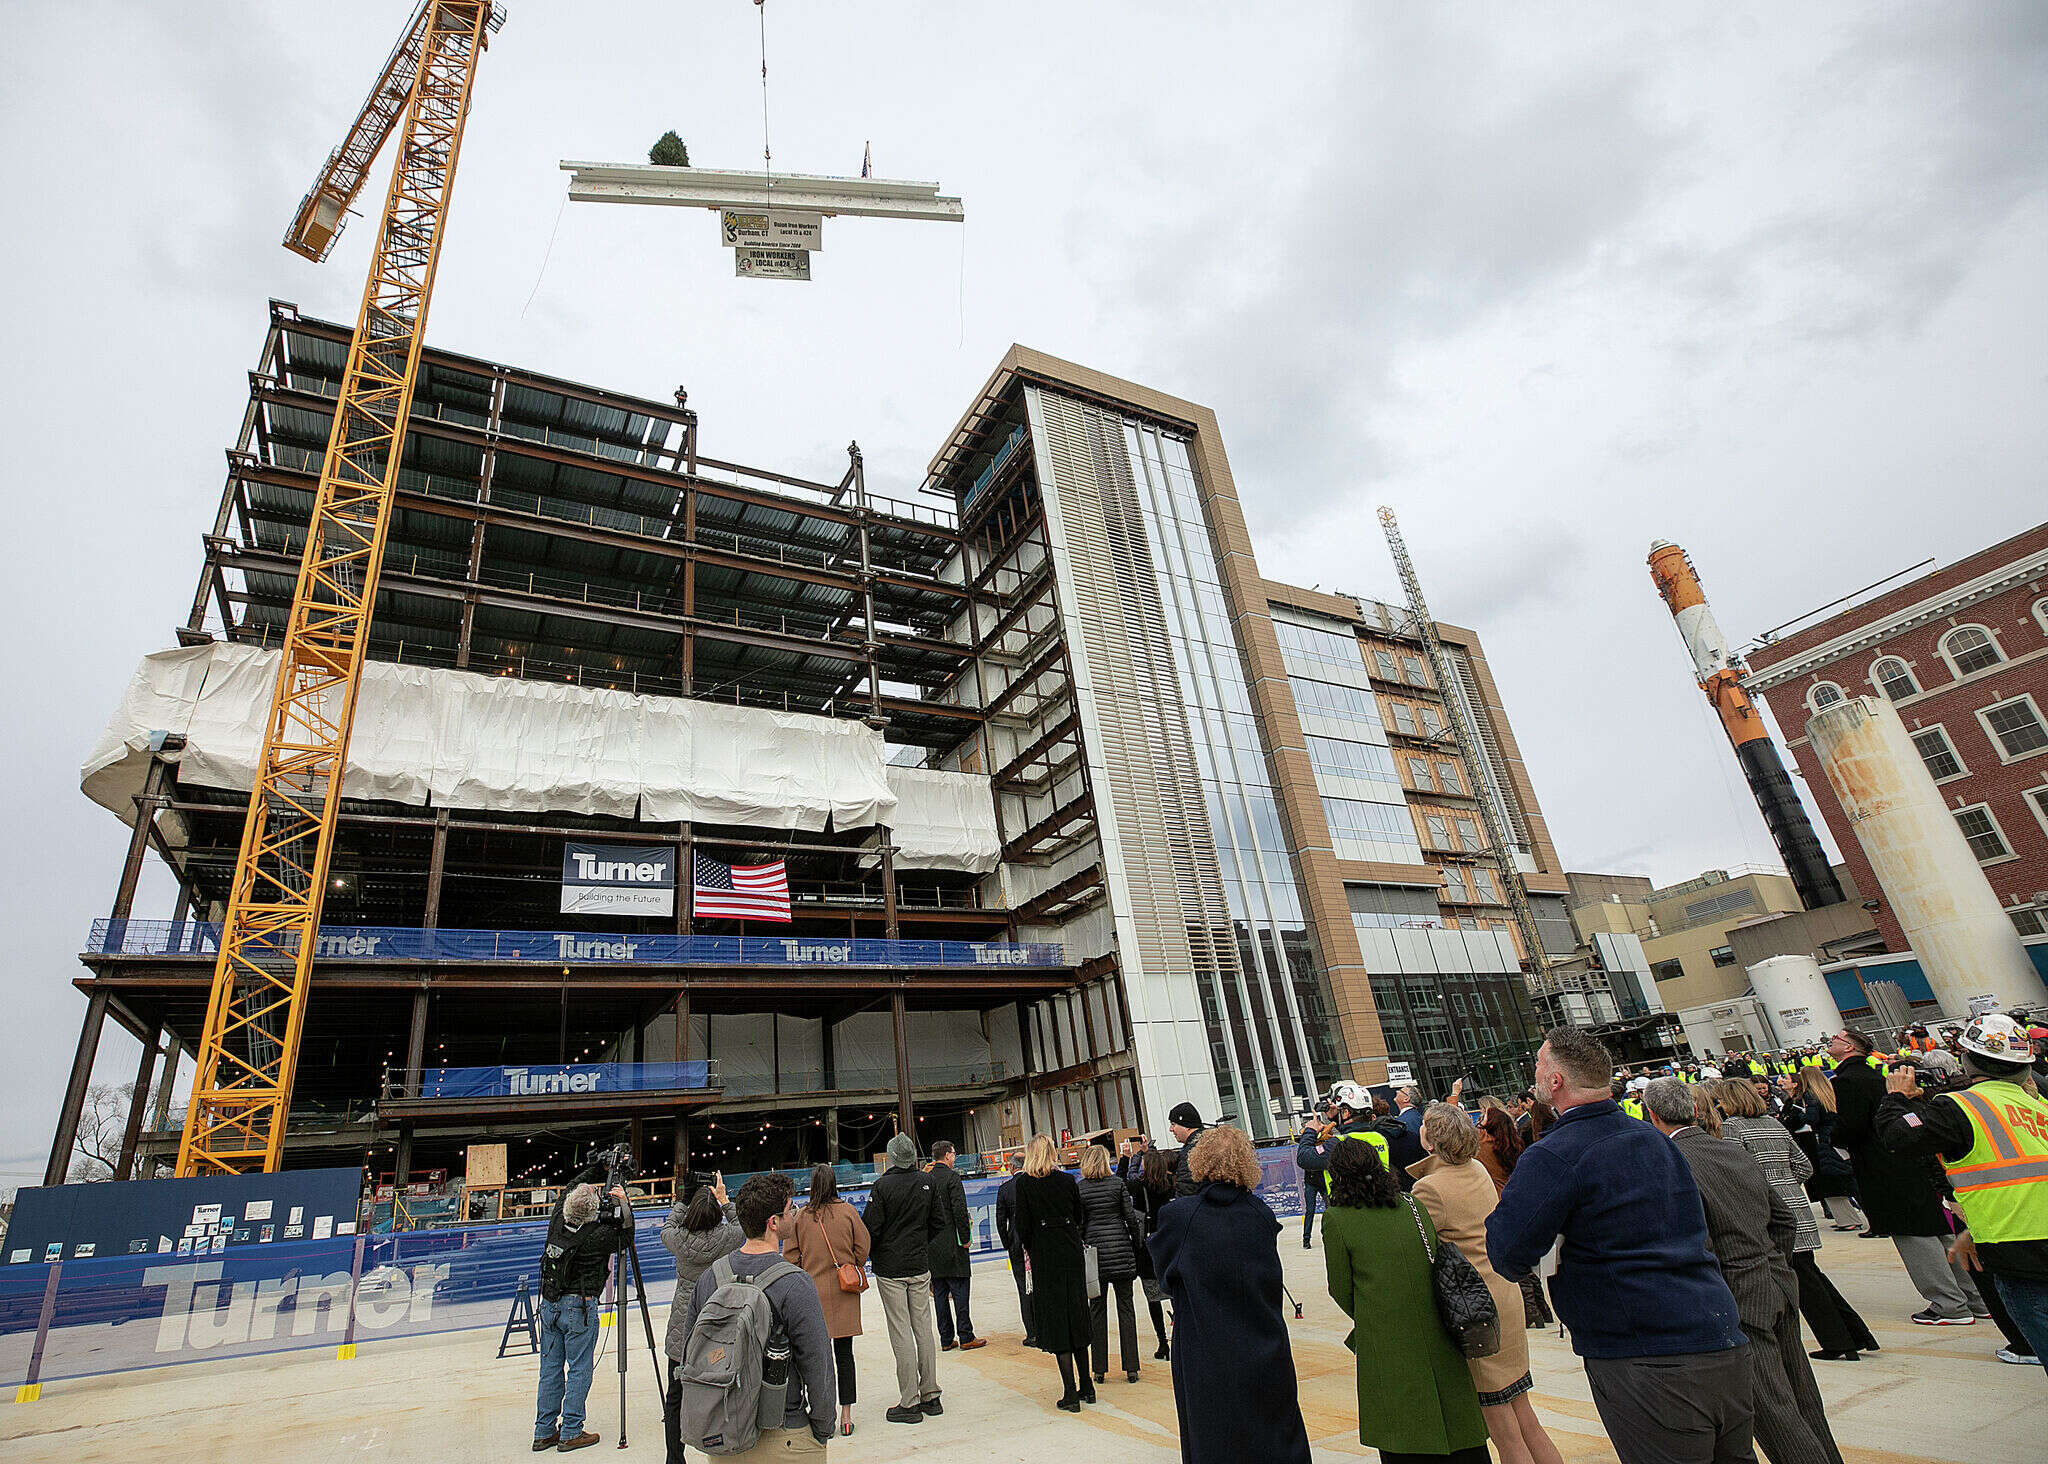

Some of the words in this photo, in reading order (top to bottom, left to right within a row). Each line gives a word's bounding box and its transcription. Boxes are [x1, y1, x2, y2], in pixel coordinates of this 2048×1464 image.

[749, 250, 765, 259] IRON
[765, 251, 796, 260] WORKERS
[755, 259, 773, 267] LOCAL
[572, 853, 667, 882] Turner
[579, 892, 613, 904] Building
[616, 893, 630, 902] the
[633, 894, 661, 903] Future
[553, 934, 637, 960] Turner
[780, 940, 851, 963] Turner
[970, 943, 1029, 964] Turner
[503, 1068, 600, 1095] Turner
[197, 1206, 220, 1214] Turner
[142, 1261, 451, 1353] Turner
